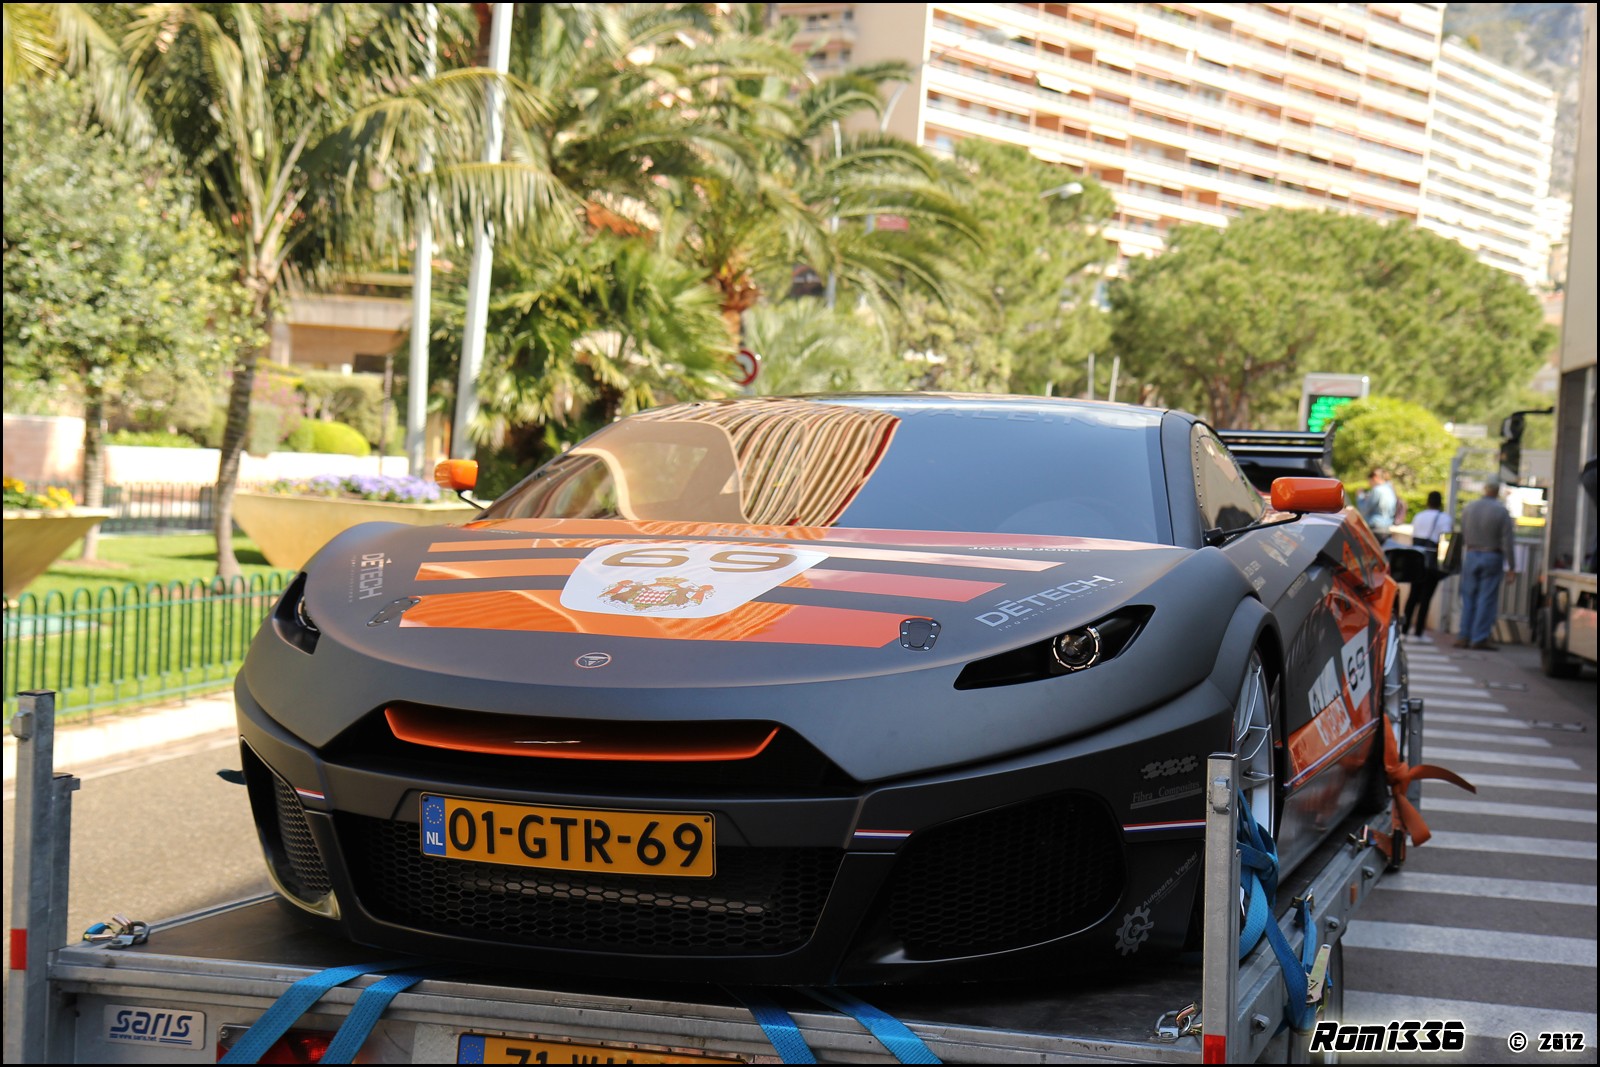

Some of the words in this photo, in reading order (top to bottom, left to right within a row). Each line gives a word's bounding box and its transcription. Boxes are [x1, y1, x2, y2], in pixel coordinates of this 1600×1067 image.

[602, 547, 798, 573] 69
[1346, 645, 1367, 692] 69
[426, 831, 443, 846] NL
[449, 807, 704, 868] 01-GTR-69
[1142, 877, 1174, 909] Autoparts
[1175, 851, 1198, 876] Veghel
[110, 1010, 193, 1038] saris
